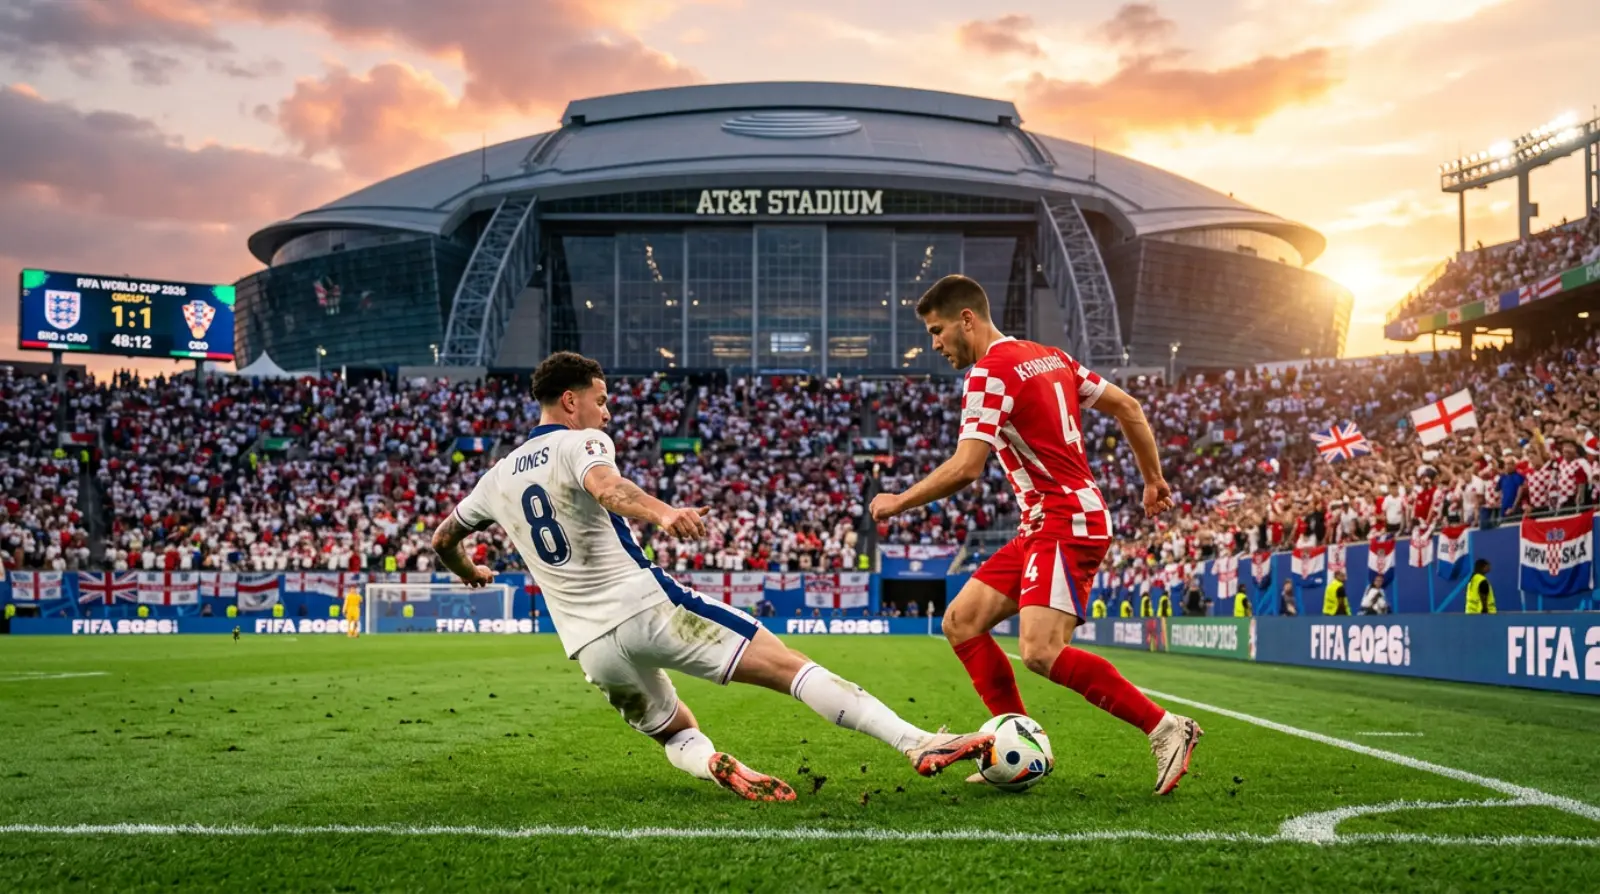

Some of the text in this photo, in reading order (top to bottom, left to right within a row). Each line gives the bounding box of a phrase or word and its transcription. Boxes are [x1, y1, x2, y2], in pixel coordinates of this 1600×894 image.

[696, 190, 883, 214] AT&T STADIUM
[111, 305, 151, 329] 1:1
[111, 334, 152, 350] 48:12
[1053, 382, 1083, 453] 4
[512, 446, 550, 475] JONES
[521, 483, 571, 567] 8
[1024, 553, 1038, 581] 4
[72, 619, 114, 634] FIFA
[117, 619, 172, 634] 2026
[255, 619, 296, 633] FIFA
[436, 619, 476, 634] FIFA
[787, 619, 828, 634] FIFA
[829, 619, 883, 634] 2026
[1311, 625, 1346, 661] FIFA
[1348, 625, 1404, 667] 2026
[1508, 627, 1579, 680] FIFA
